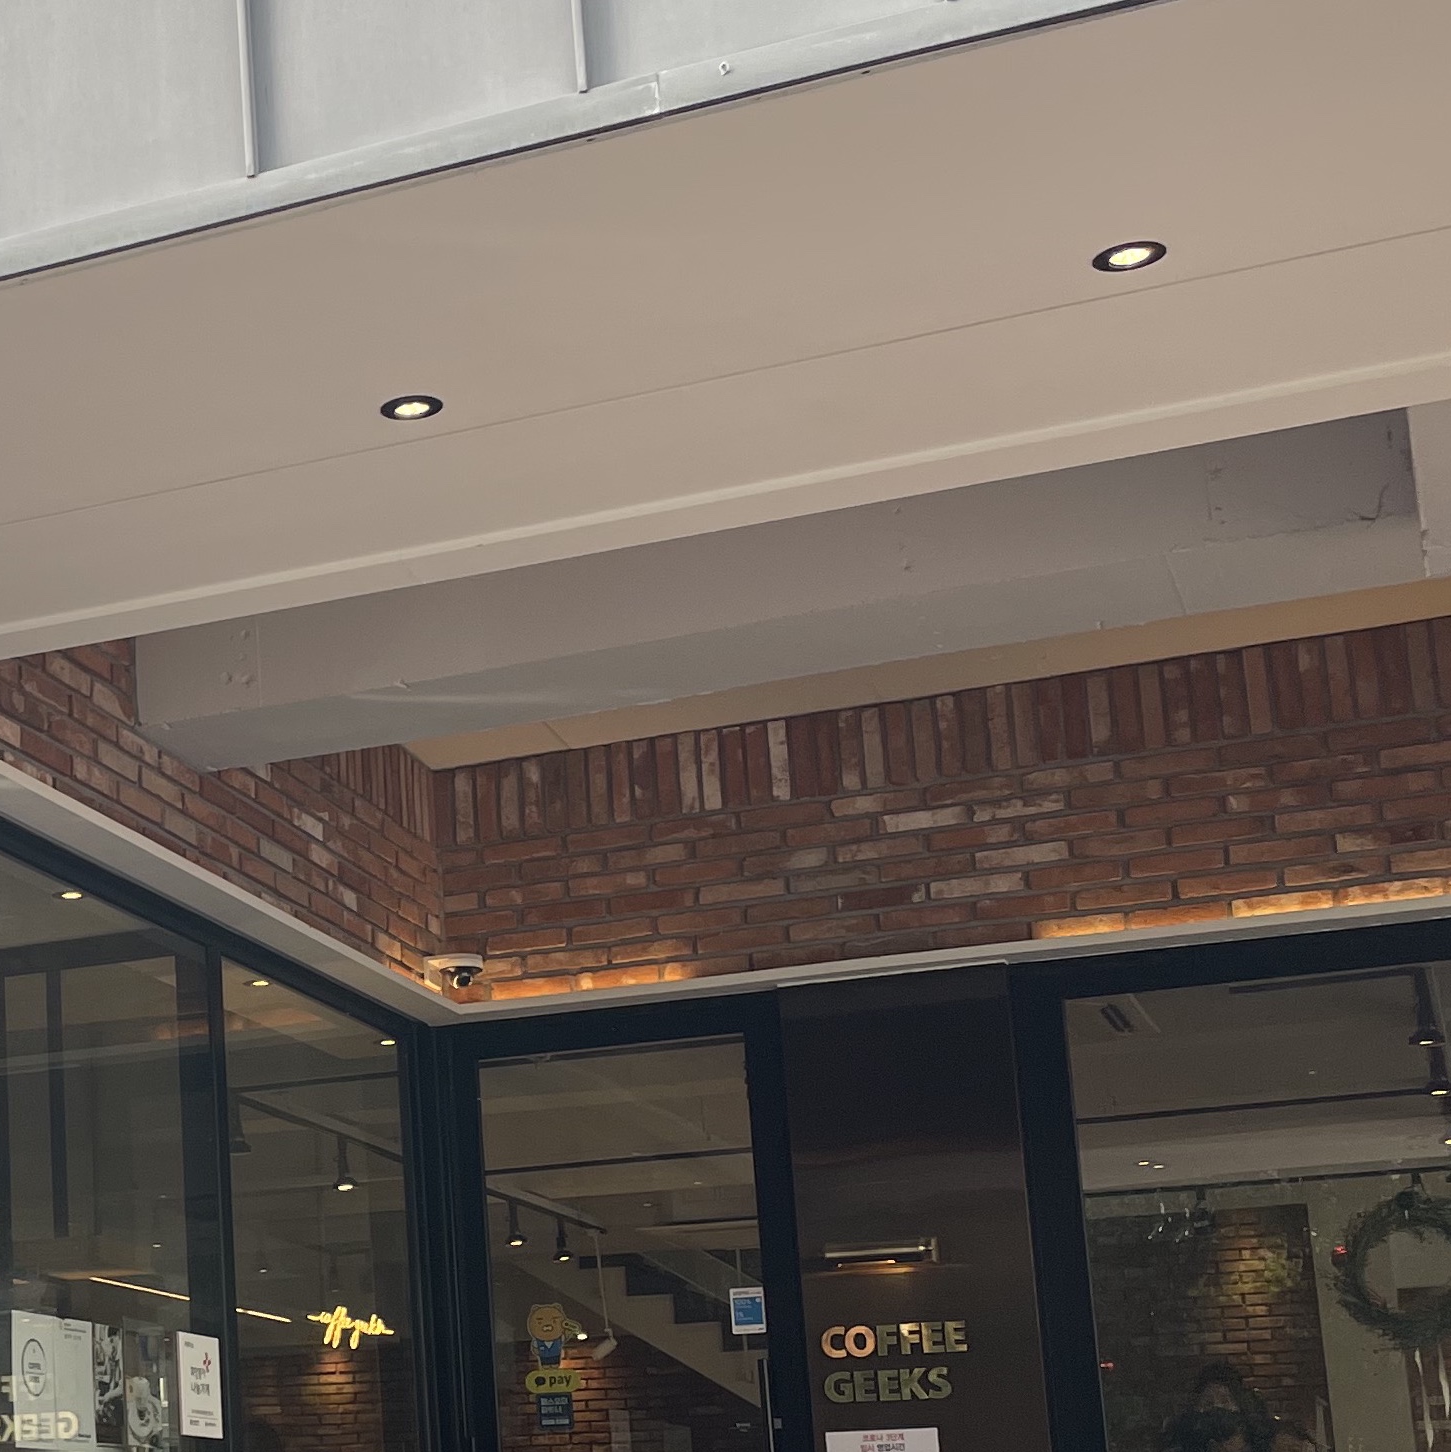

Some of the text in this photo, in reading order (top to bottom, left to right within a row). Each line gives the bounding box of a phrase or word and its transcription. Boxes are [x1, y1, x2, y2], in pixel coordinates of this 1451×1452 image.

[821, 1320, 968, 1358] COFFEE
[549, 1375, 572, 1387] pay
[823, 1366, 953, 1403] GEEKS
